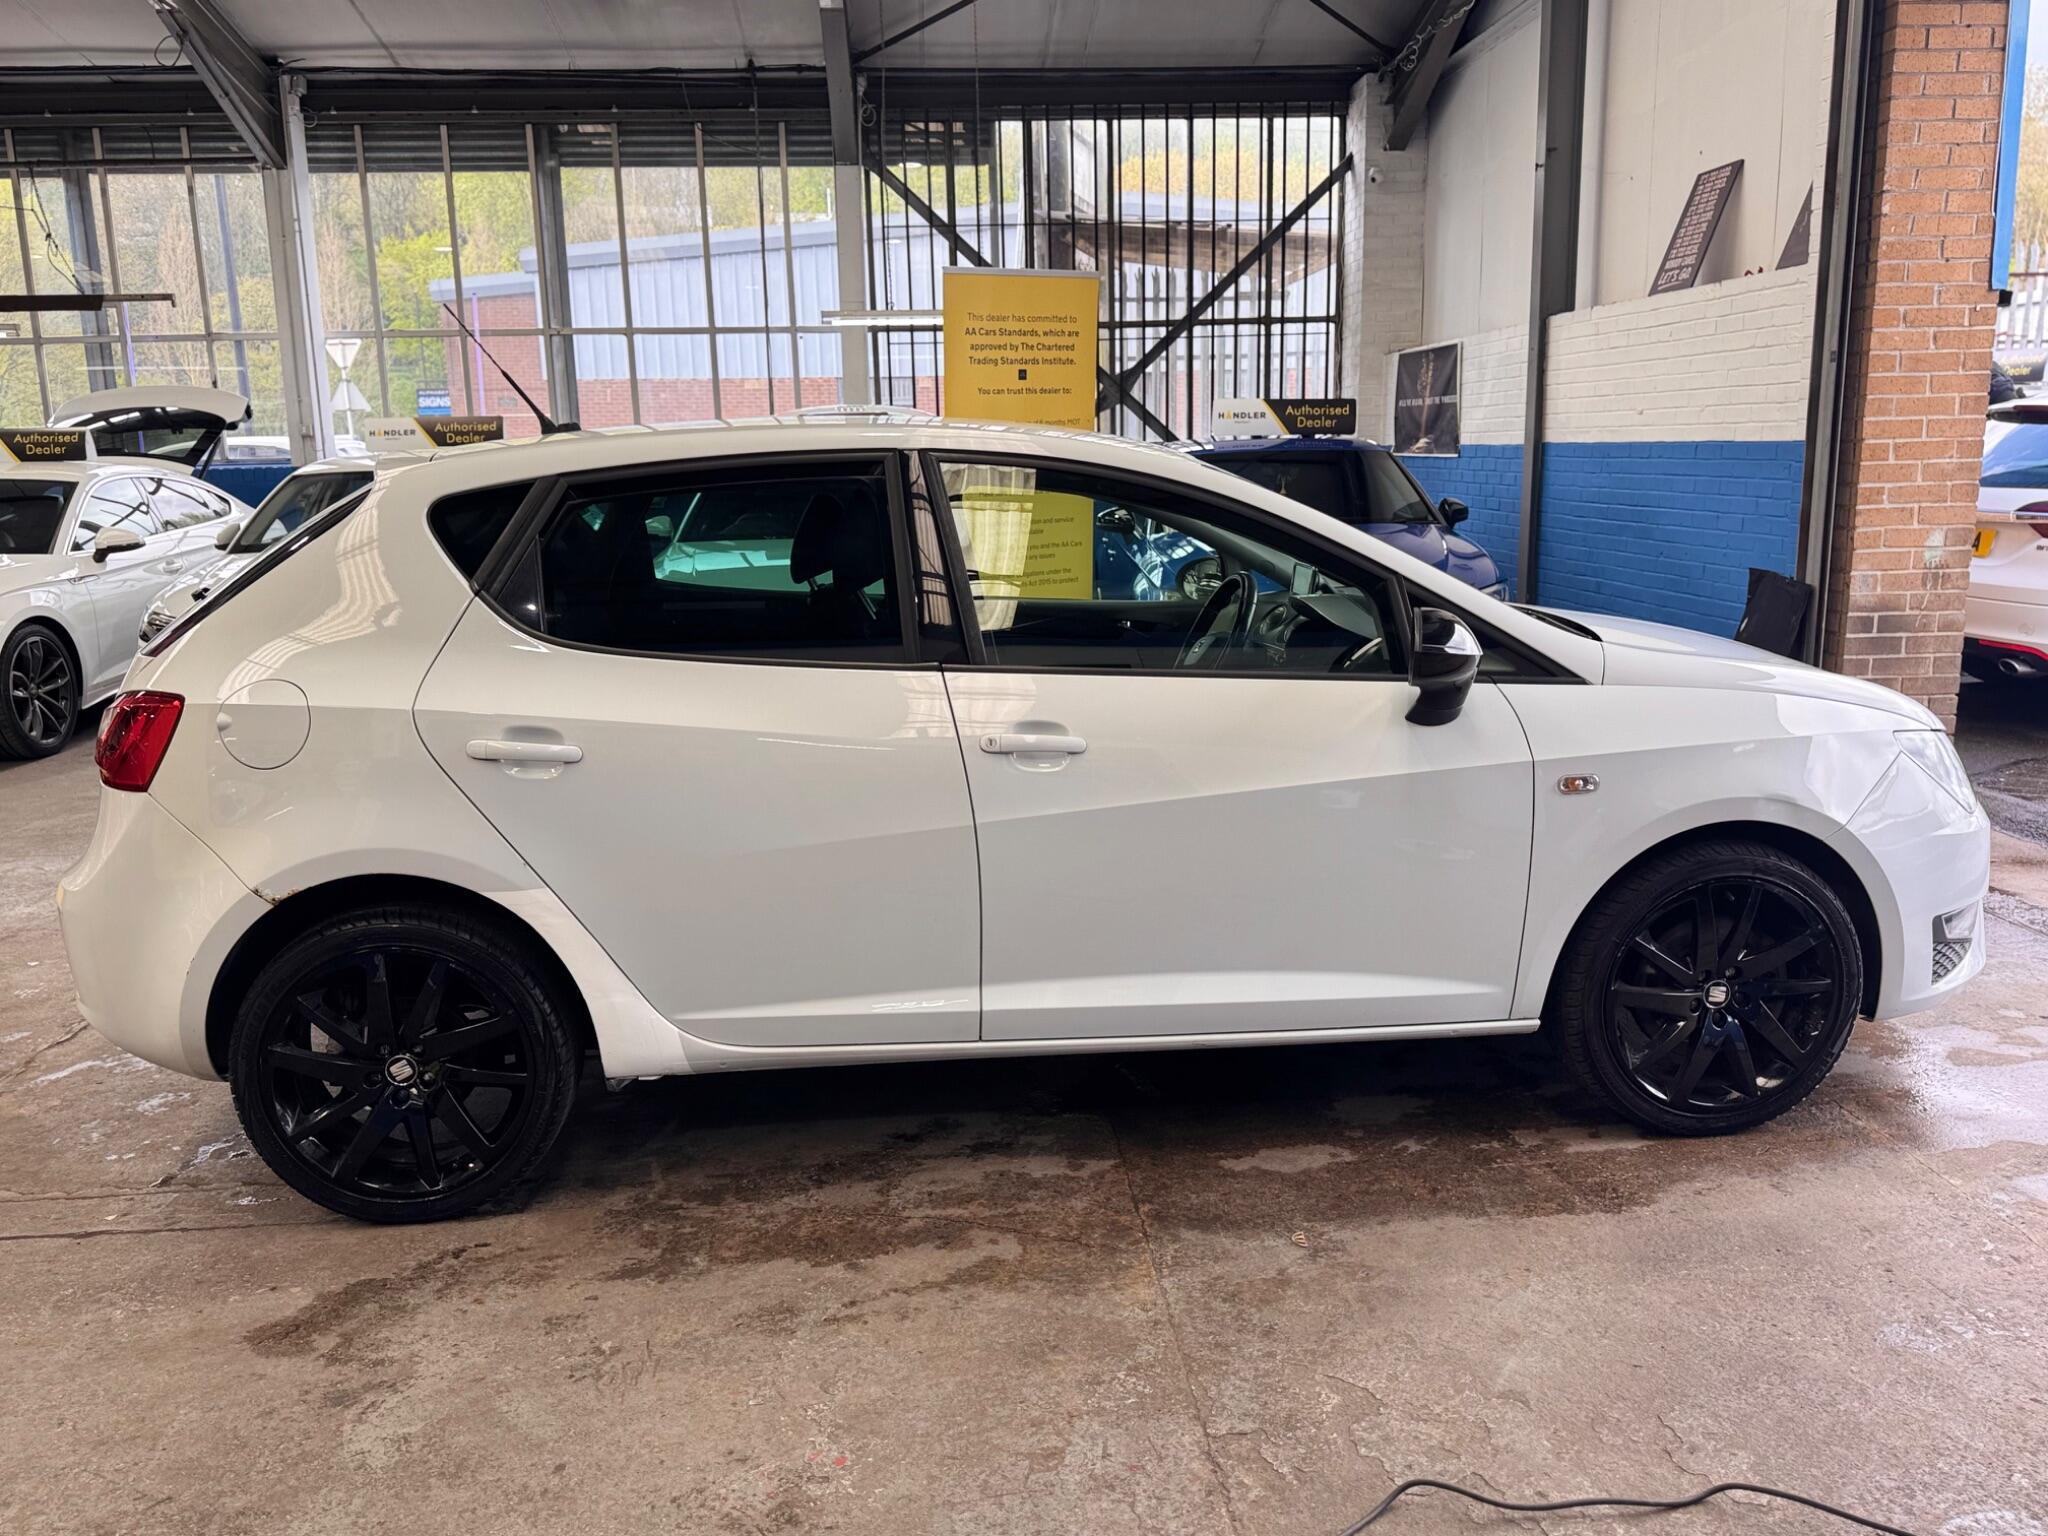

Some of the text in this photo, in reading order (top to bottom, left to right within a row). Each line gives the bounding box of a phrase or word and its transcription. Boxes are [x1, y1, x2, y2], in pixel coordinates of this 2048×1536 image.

[967, 312, 1077, 323] This dealer has committed to
[965, 328, 976, 336] AA
[978, 328, 996, 337] Cars
[998, 328, 1041, 338] Standards,
[1042, 329, 1065, 337] which
[970, 342, 1075, 352] approved by The Chartered
[968, 356, 1077, 366] Trading Standards Institute.
[977, 387, 990, 395] You
[1007, 387, 1024, 395] trust
[1025, 387, 1037, 395] this
[418, 396, 451, 408] SIGNS
[1285, 404, 1350, 415] Authorised
[434, 421, 497, 432] Authorised
[1297, 417, 1337, 428] Dealer
[13, 432, 79, 443] Authorised
[446, 432, 486, 443] Dealer
[25, 444, 66, 455] Dealer
